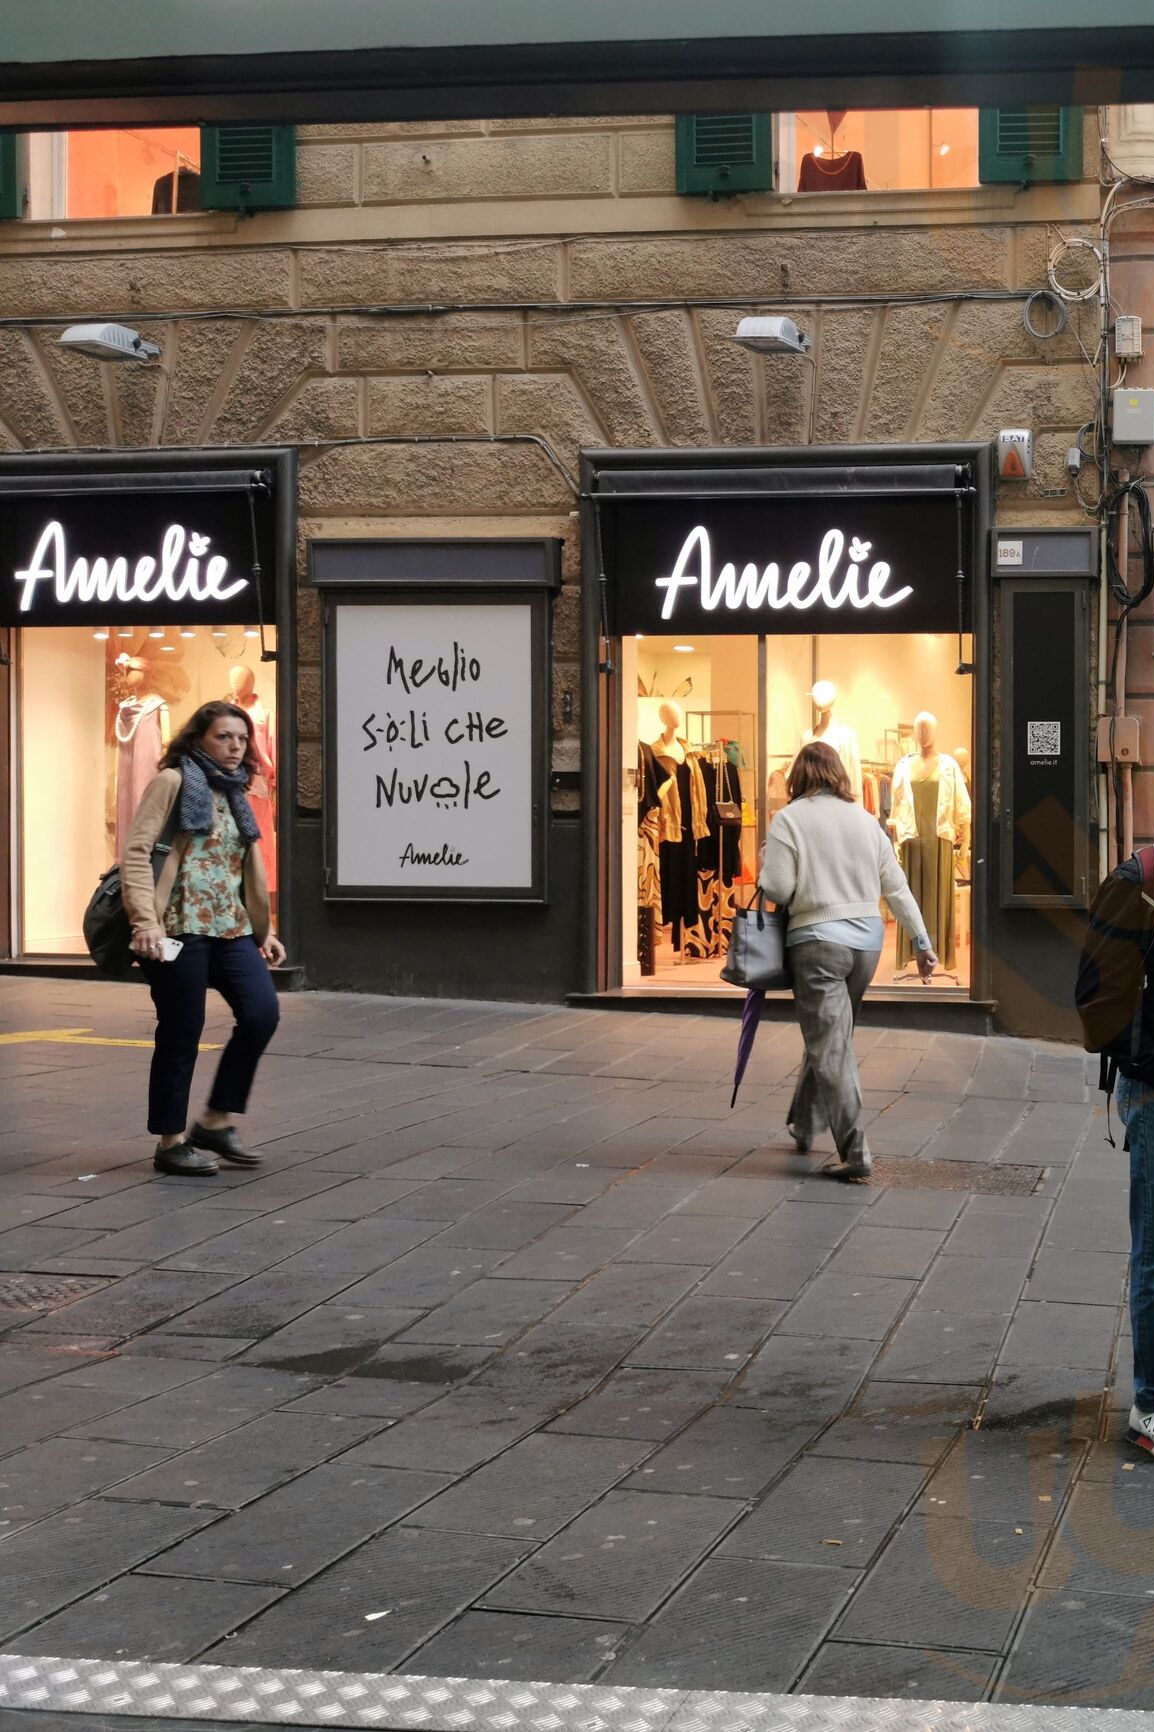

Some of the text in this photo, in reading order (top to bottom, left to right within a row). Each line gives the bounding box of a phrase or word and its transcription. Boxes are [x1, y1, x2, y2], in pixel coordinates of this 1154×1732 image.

[14, 520, 249, 612] Amelie
[655, 525, 913, 620] Amelie
[1030, 758, 1058, 766] amelie.it
[399, 842, 470, 868] Amelie
